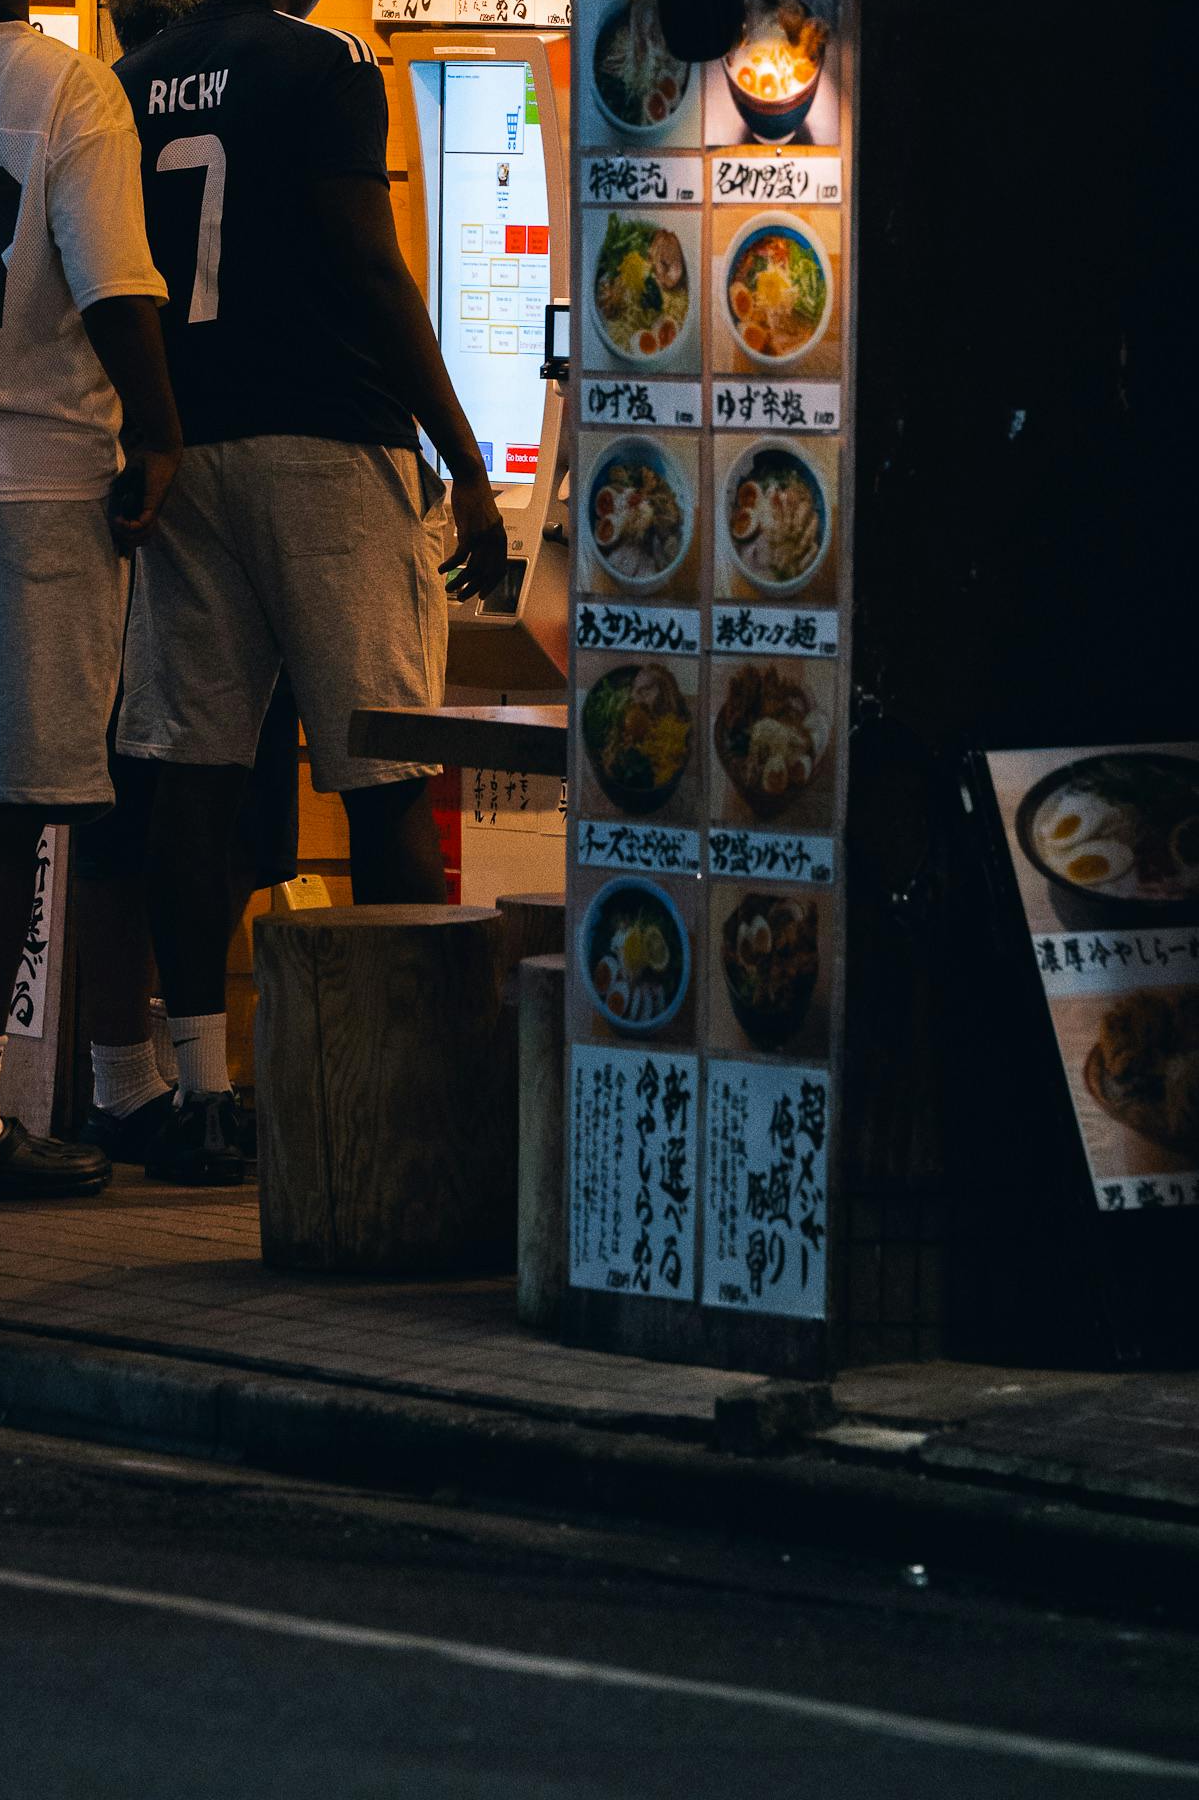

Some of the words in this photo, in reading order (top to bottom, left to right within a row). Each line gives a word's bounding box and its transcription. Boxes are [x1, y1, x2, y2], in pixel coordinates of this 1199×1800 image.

[148, 68, 229, 115] RICKY
[589, 161, 668, 201] 特俺流
[716, 162, 810, 200] 名物男盛り
[156, 134, 227, 324] 7
[588, 383, 657, 423] ゆず塩
[717, 386, 807, 426] ゆず辛塩
[475, 768, 486, 824] イボール
[490, 770, 499, 825] ーロンハイ
[519, 772, 529, 811] モン
[658, 1064, 691, 1291] 新選べる
